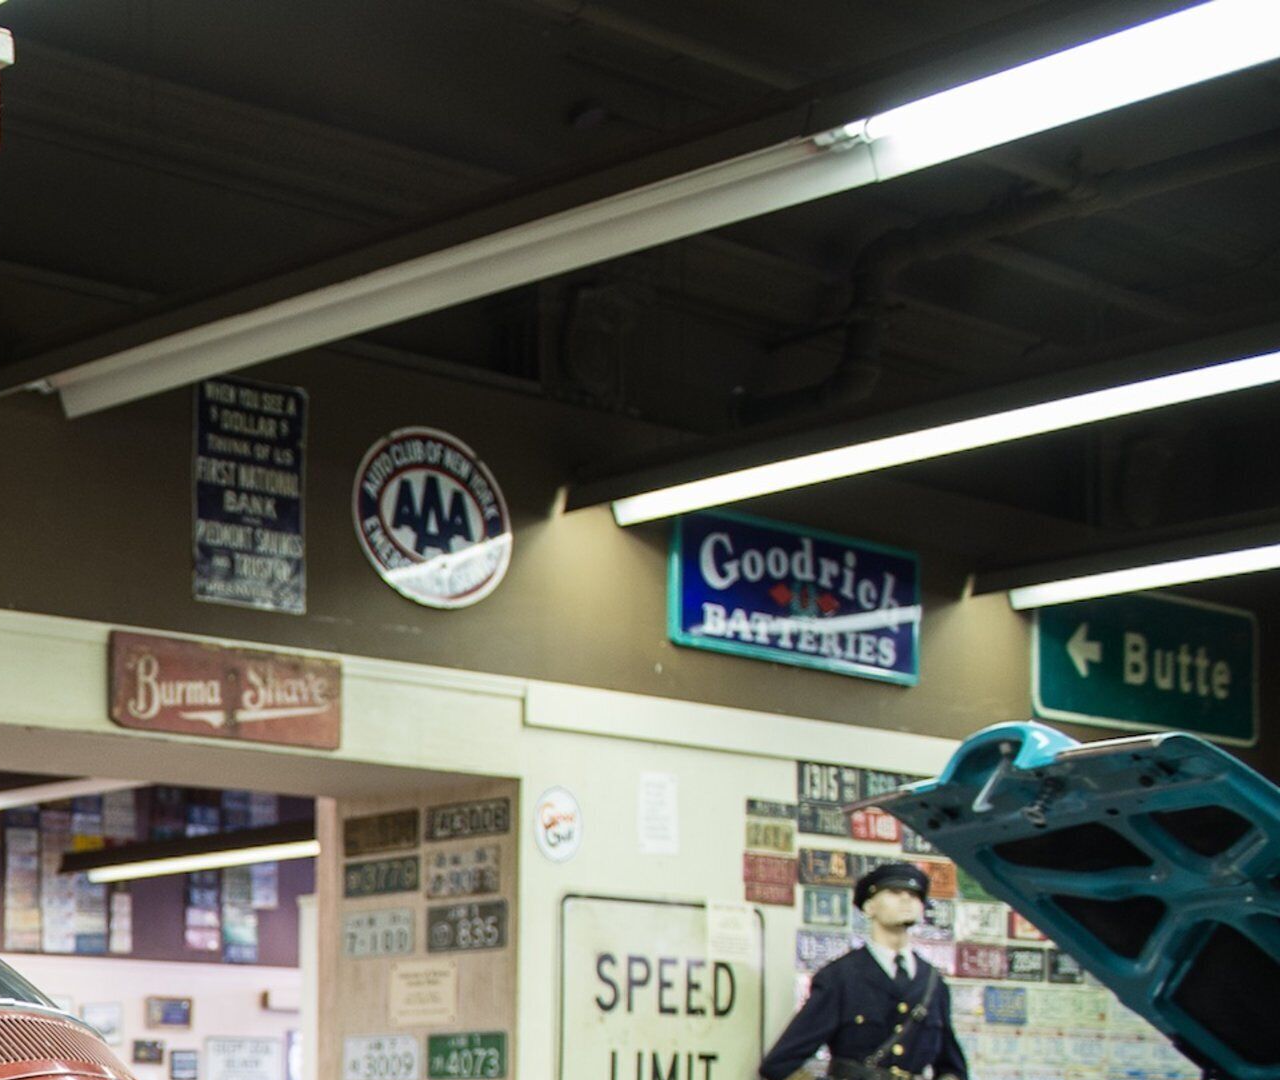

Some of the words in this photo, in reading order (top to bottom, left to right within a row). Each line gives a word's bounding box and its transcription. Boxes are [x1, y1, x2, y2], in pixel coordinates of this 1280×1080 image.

[363, 452, 393, 498] AUTO
[391, 439, 425, 467] CLUB
[426, 440, 444, 464] OF
[443, 449, 472, 480] NEW
[223, 489, 278, 519] BANK
[392, 473, 477, 556] AAA
[700, 532, 901, 633] Goodrich
[701, 602, 898, 669] BATTERIES
[1123, 632, 1232, 700] Butte
[126, 654, 223, 721] Burma
[241, 662, 330, 710] Shave
[595, 952, 737, 1019] SPEED
[446, 1047, 500, 1078] 4073
